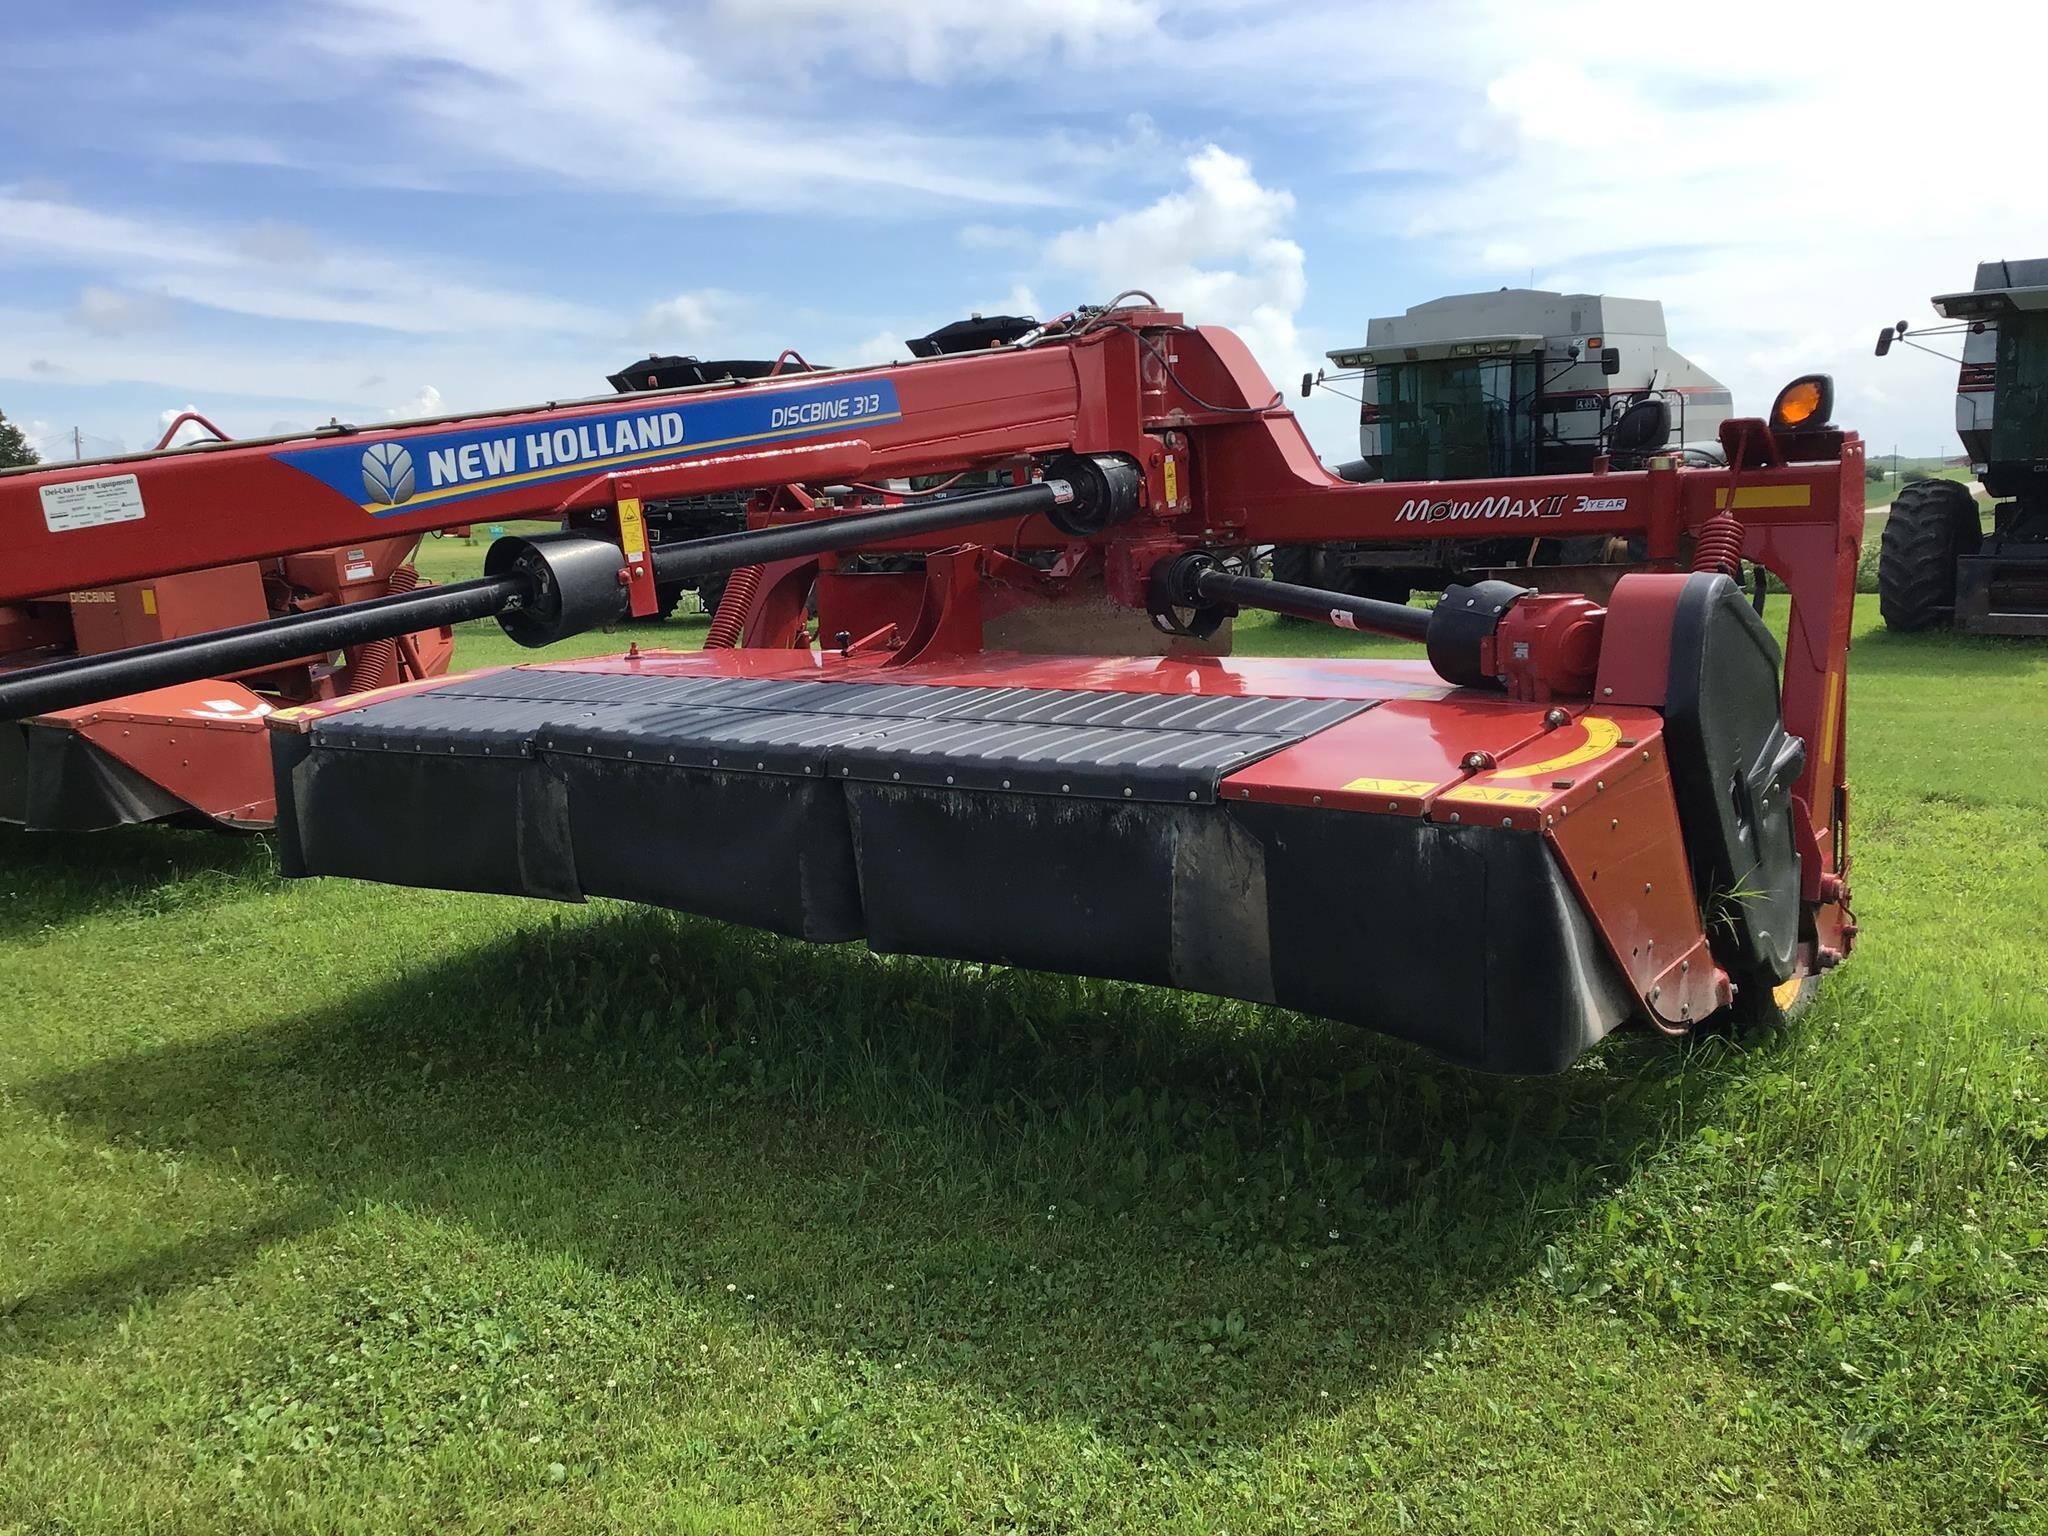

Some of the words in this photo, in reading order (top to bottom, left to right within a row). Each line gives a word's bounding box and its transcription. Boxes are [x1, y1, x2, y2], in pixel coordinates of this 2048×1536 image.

[771, 398, 850, 429] DISCBINE
[853, 393, 880, 416] 313
[428, 437, 516, 486] NEW
[525, 412, 685, 469] HOLLAND
[76, 484, 95, 492] Farm
[97, 478, 134, 489] Equipment
[69, 591, 117, 603] DISCBINE
